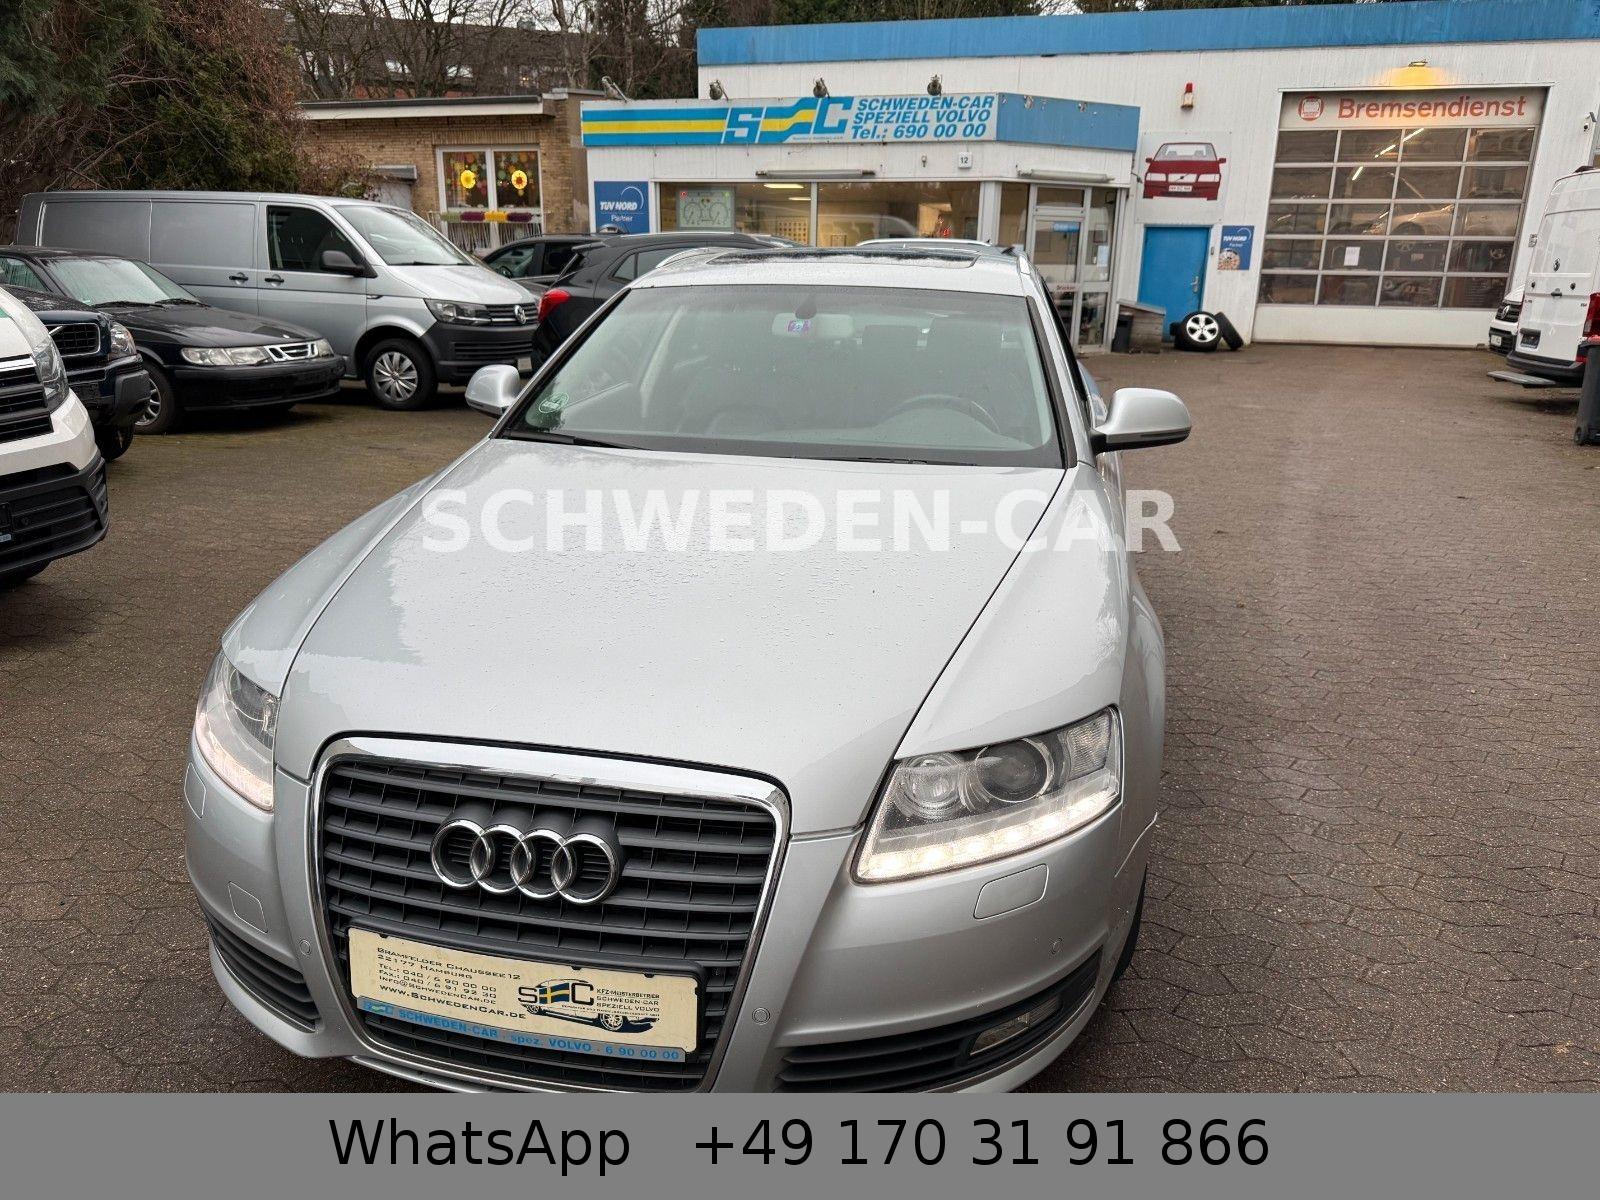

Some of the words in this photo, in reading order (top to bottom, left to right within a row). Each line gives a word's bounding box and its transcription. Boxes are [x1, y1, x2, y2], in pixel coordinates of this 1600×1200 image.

[857, 95, 995, 111] SCHWEDEN-CAR
[1338, 95, 1527, 119] Bremsendienst
[853, 110, 930, 124] SPEZIELL
[936, 108, 991, 123] VOLVO
[851, 125, 888, 139] Tel.:
[893, 123, 928, 139] 690
[933, 123, 957, 138] 00
[962, 123, 987, 138] 00
[960, 156, 969, 164] 12
[615, 201, 638, 211] NORD
[377, 954, 415, 967] 22177
[402, 969, 423, 978] 040
[444, 978, 459, 986] 90
[403, 975, 424, 984] 040
[399, 1008, 498, 1038] SCHWEDEN-CAR
[549, 1038, 592, 1052] VOLVO
[605, 1047, 614, 1055] 6
[618, 1047, 635, 1057] 90
[640, 1049, 658, 1059] 00
[662, 1051, 680, 1060] 00
